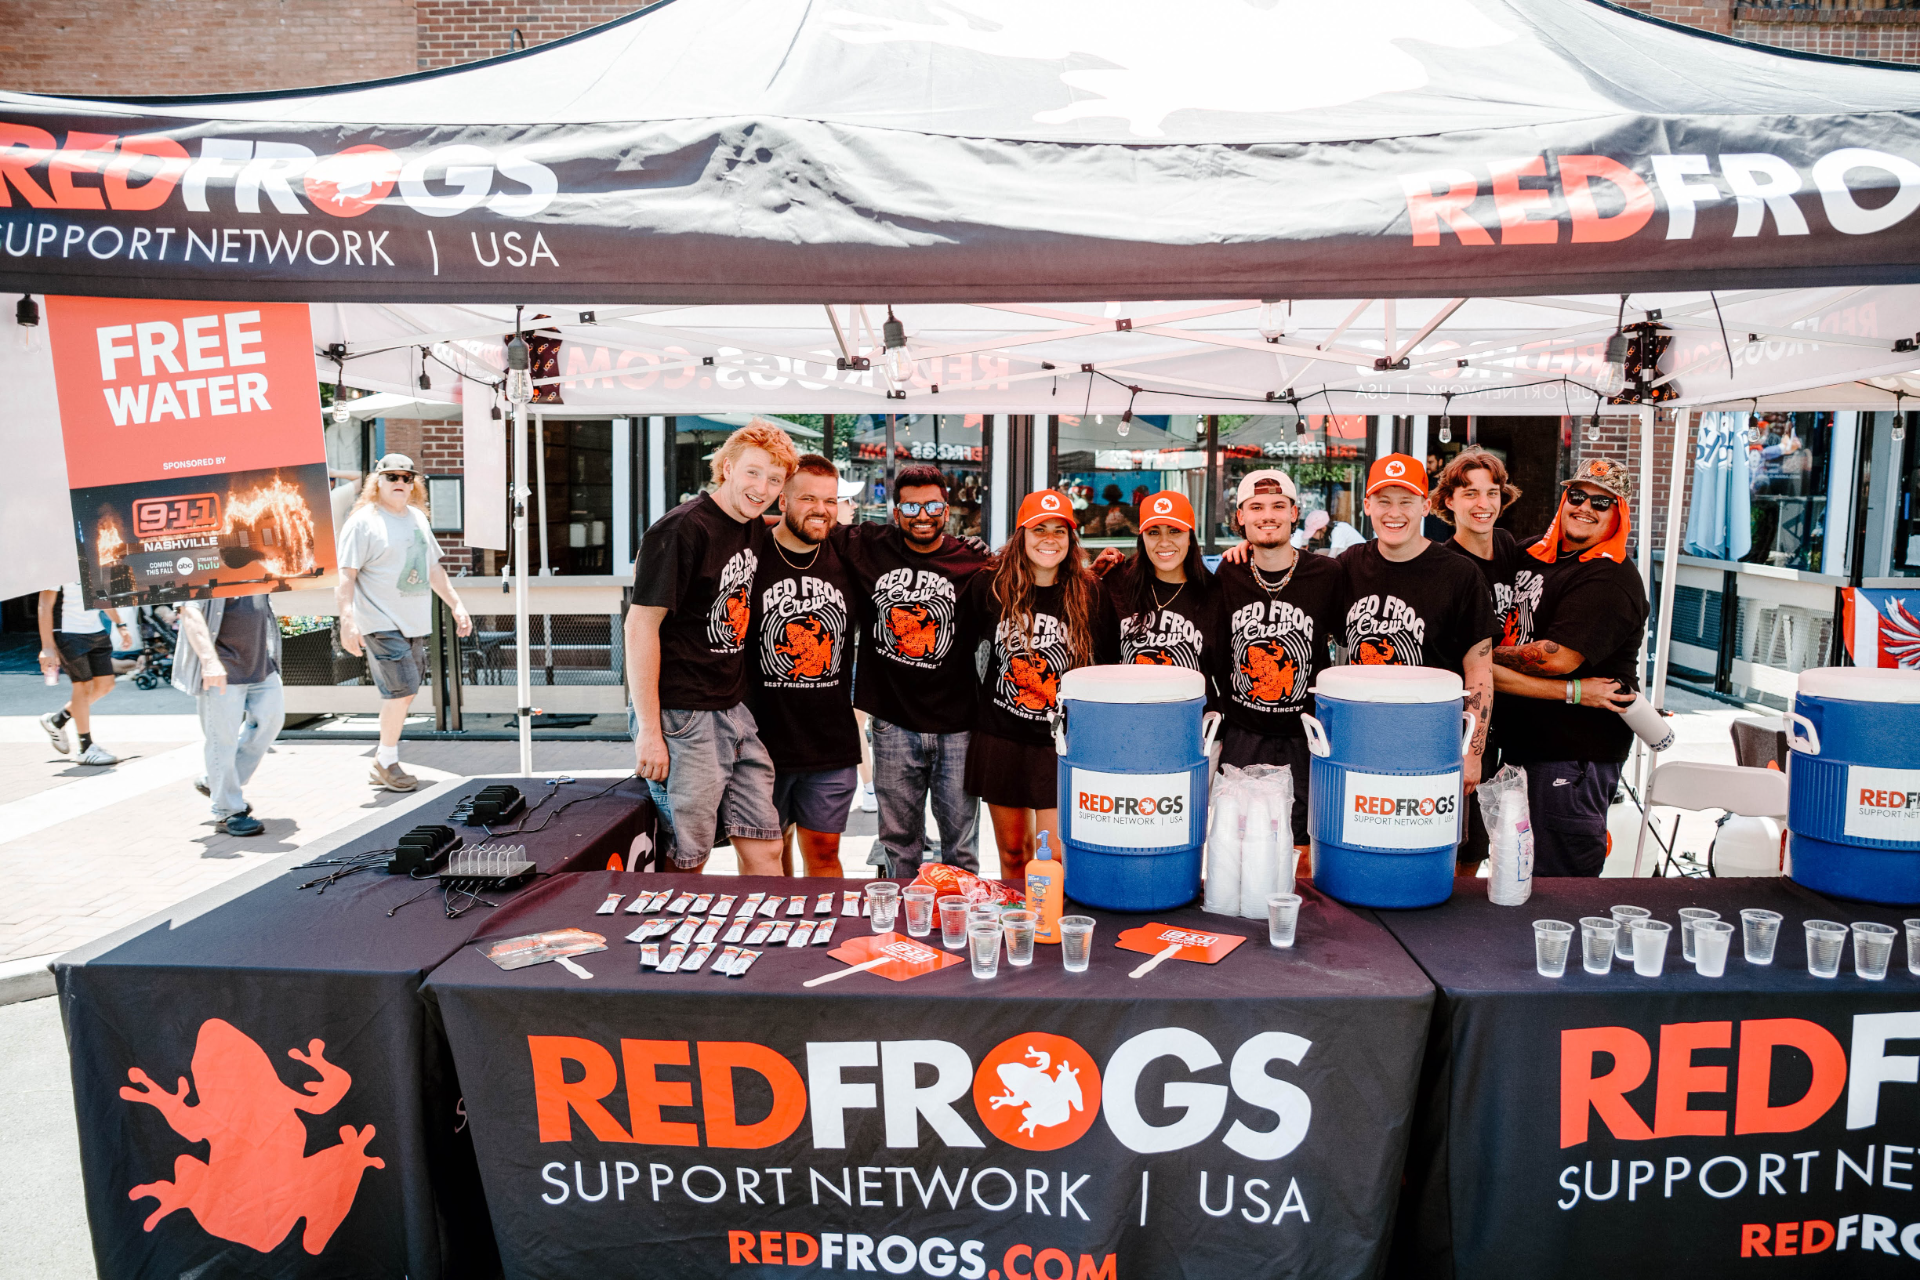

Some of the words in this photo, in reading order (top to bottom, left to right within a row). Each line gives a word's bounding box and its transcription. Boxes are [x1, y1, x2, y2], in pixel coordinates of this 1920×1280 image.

[0, 121, 559, 217] REDFROGS
[1398, 147, 1920, 247] REDFRO
[0, 222, 176, 261] UPPORT
[184, 228, 395, 266] NETWORK
[472, 232, 560, 267] USA
[96, 310, 266, 381] FREE
[103, 372, 272, 426] WATER
[163, 458, 214, 470] SPONSORED
[216, 456, 226, 465] BY
[144, 536, 219, 552] NASHVILLE
[197, 561, 220, 570] hulu
[719, 552, 744, 591] RED
[763, 578, 797, 614] RED
[801, 576, 847, 614] FROG
[875, 567, 913, 592] RED
[915, 570, 956, 603] FROG
[887, 583, 937, 602] Crew
[778, 595, 829, 617] Crew
[1231, 601, 1265, 633] RED
[1268, 600, 1314, 641] FROG
[1346, 594, 1380, 626] RED
[1382, 595, 1426, 646] FROG
[1033, 613, 1075, 656] FRO
[1131, 628, 1187, 648] Crew
[1160, 610, 1203, 656] FROG
[1243, 617, 1296, 640] Crew
[1357, 613, 1406, 636] Crew
[1007, 705, 1034, 720] FRIENDS
[1243, 701, 1271, 713] FRIENDS
[1079, 791, 1183, 815] REDFROGS
[1354, 795, 1455, 816] REDFROGS
[1859, 807, 1901, 818] SUPPORT
[1860, 788, 1920, 809] REDF
[1079, 811, 1111, 823] SUPPORT
[1113, 817, 1155, 825] NETWORK
[1170, 816, 1183, 824] USA
[1354, 814, 1392, 825] SUPPORT
[1394, 818, 1433, 826] NETWORK
[1444, 815, 1454, 823] USA
[527, 1027, 1313, 1160] REDFROGS
[1560, 1011, 1920, 1149] REDF
[541, 1162, 793, 1206] SUPPORT
[811, 1165, 1091, 1222] NETWORK
[1200, 1170, 1311, 1225] USA
[1558, 1150, 1820, 1210] SUPPORT
[1835, 1144, 1920, 1192] NE
[728, 1230, 1118, 1280] REDFROGS.COM
